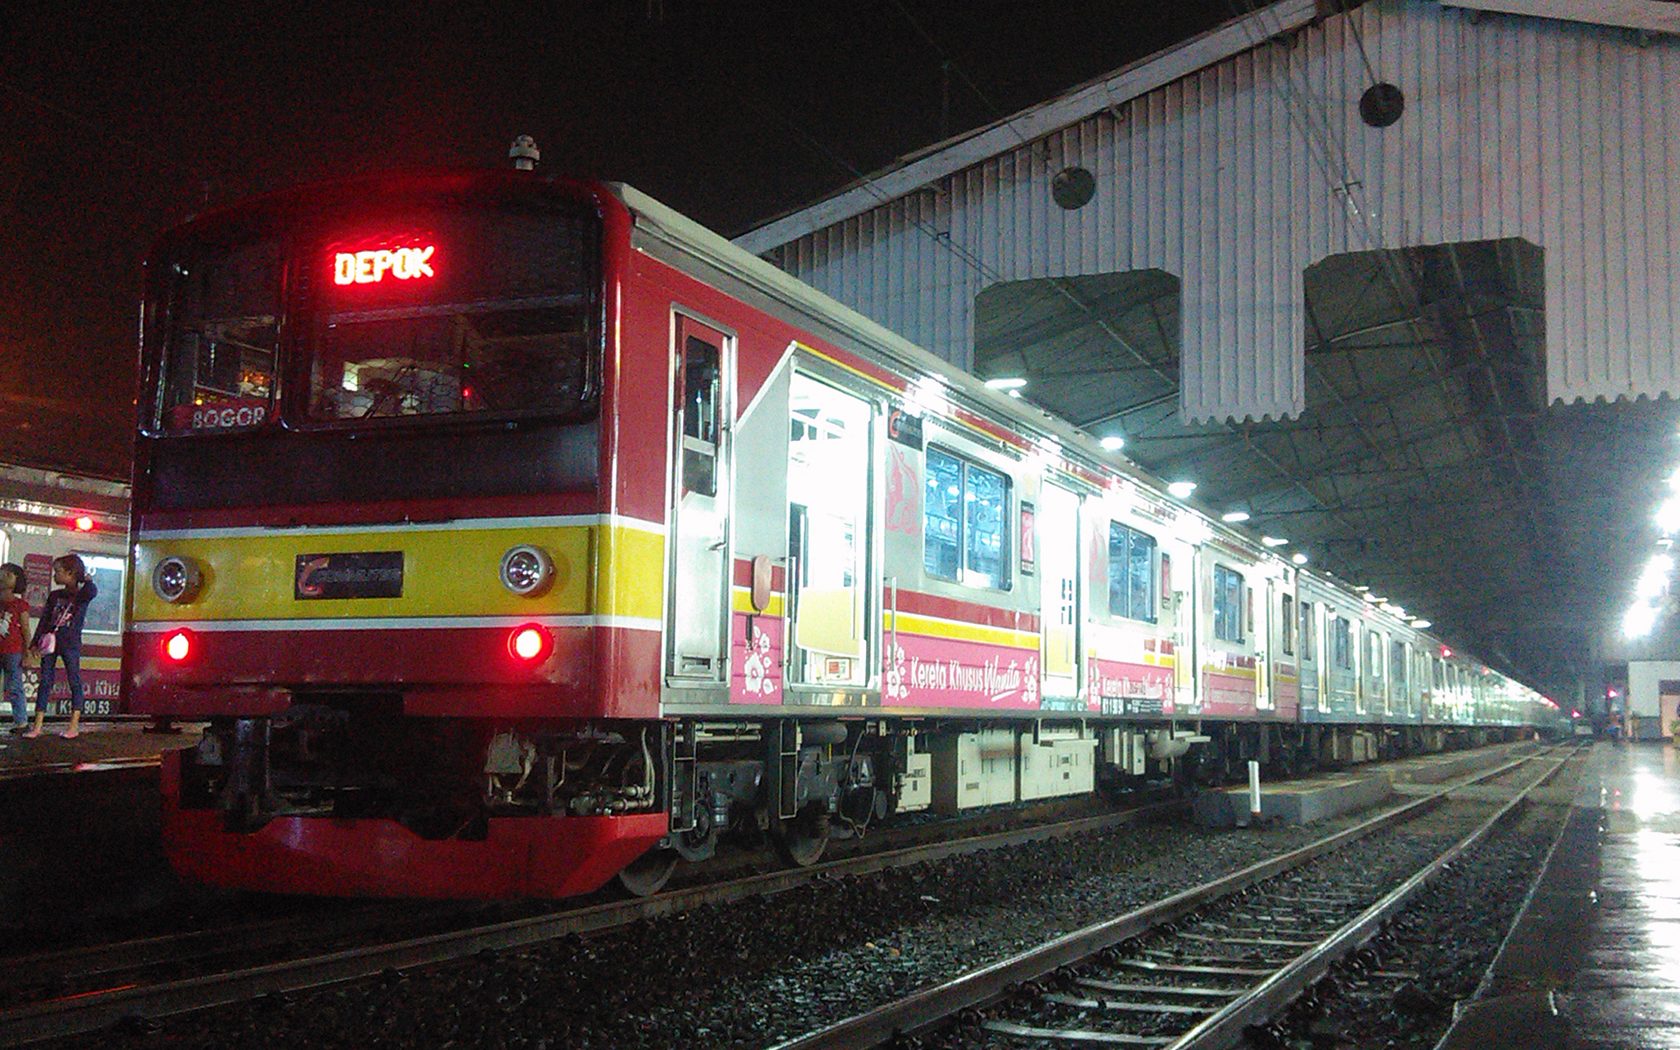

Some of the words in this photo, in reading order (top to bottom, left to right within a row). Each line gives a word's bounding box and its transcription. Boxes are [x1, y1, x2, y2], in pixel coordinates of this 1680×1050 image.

[335, 246, 434, 285] DEPOK
[192, 407, 265, 429] BOGOR
[911, 657, 946, 690] Kereta
[949, 660, 983, 692] Khusus
[984, 655, 1020, 696] Wanita
[98, 700, 110, 715] 53
